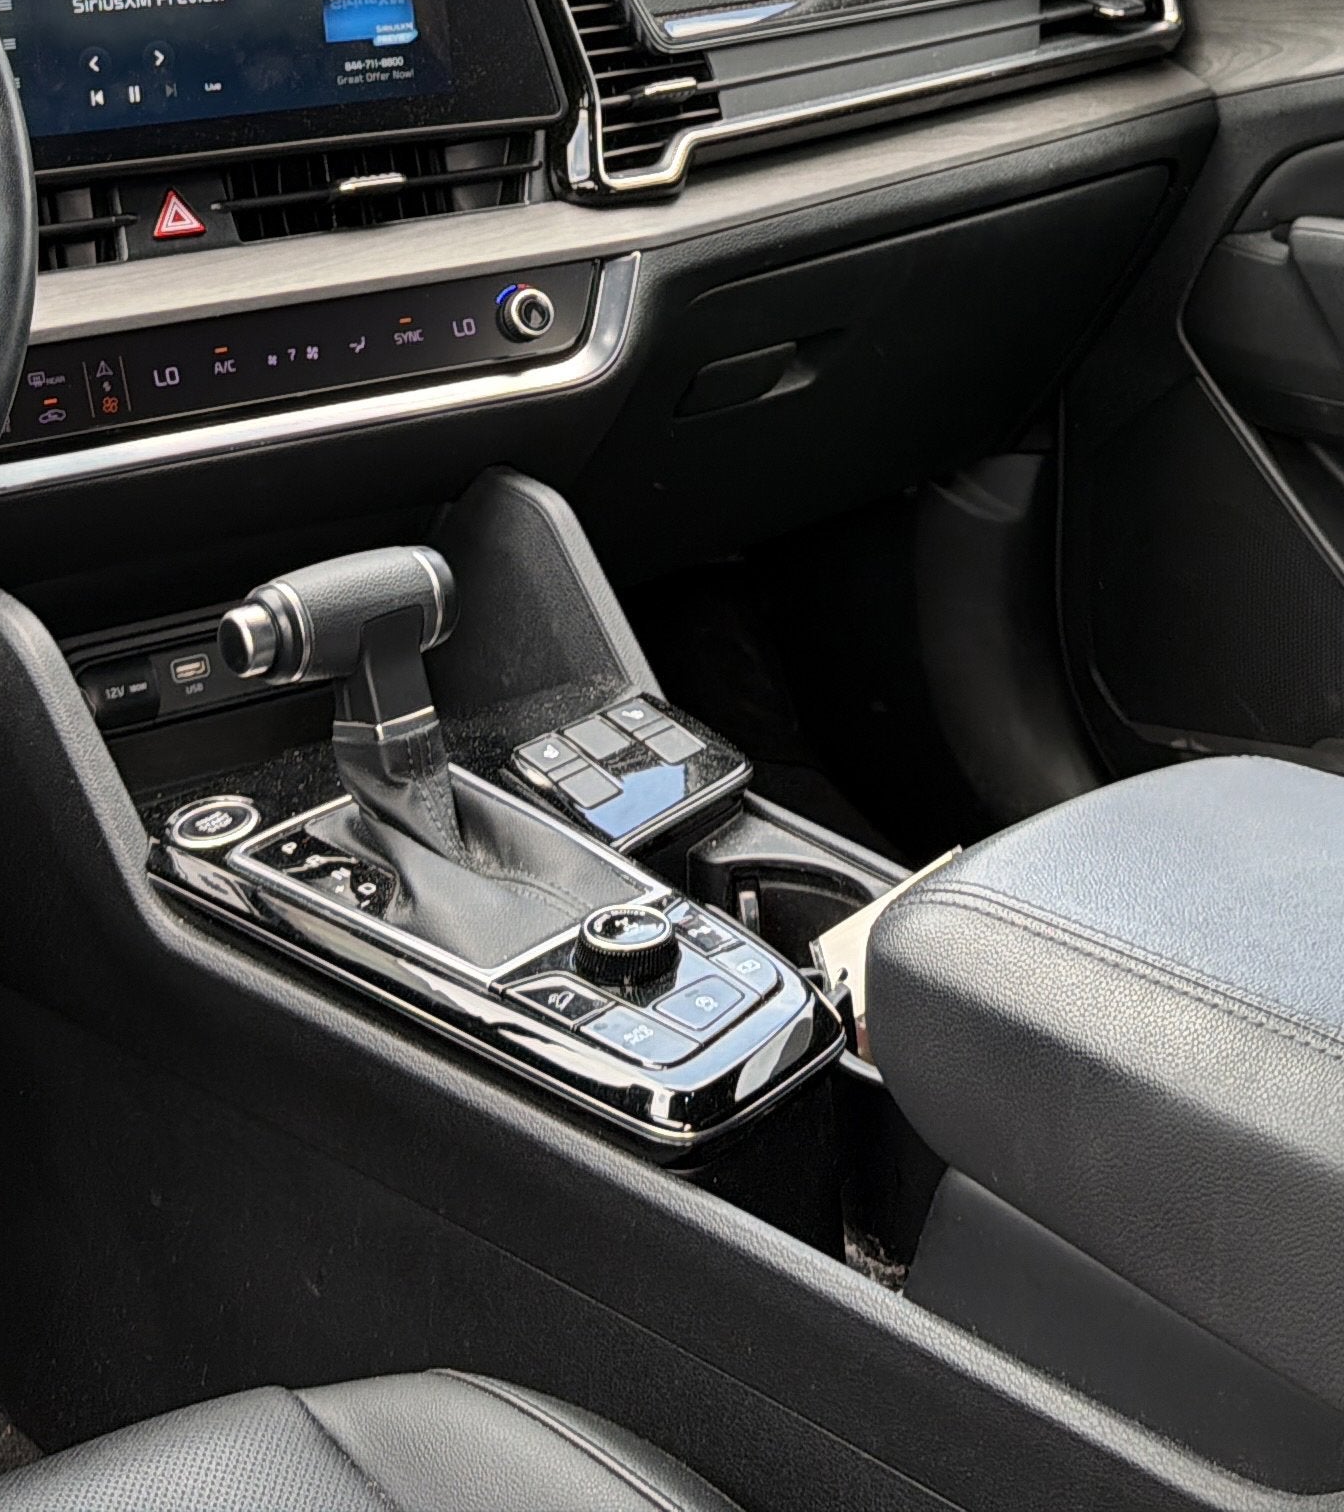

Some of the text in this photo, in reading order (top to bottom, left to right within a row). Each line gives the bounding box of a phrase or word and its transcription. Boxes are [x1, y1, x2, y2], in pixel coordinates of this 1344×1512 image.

[337, 74, 364, 86] Great
[366, 71, 391, 83] Offer
[452, 318, 476, 338] LO
[394, 329, 424, 345] SYNC
[214, 359, 236, 376] A/C
[153, 367, 180, 388] LO
[104, 685, 125, 700] 12V
